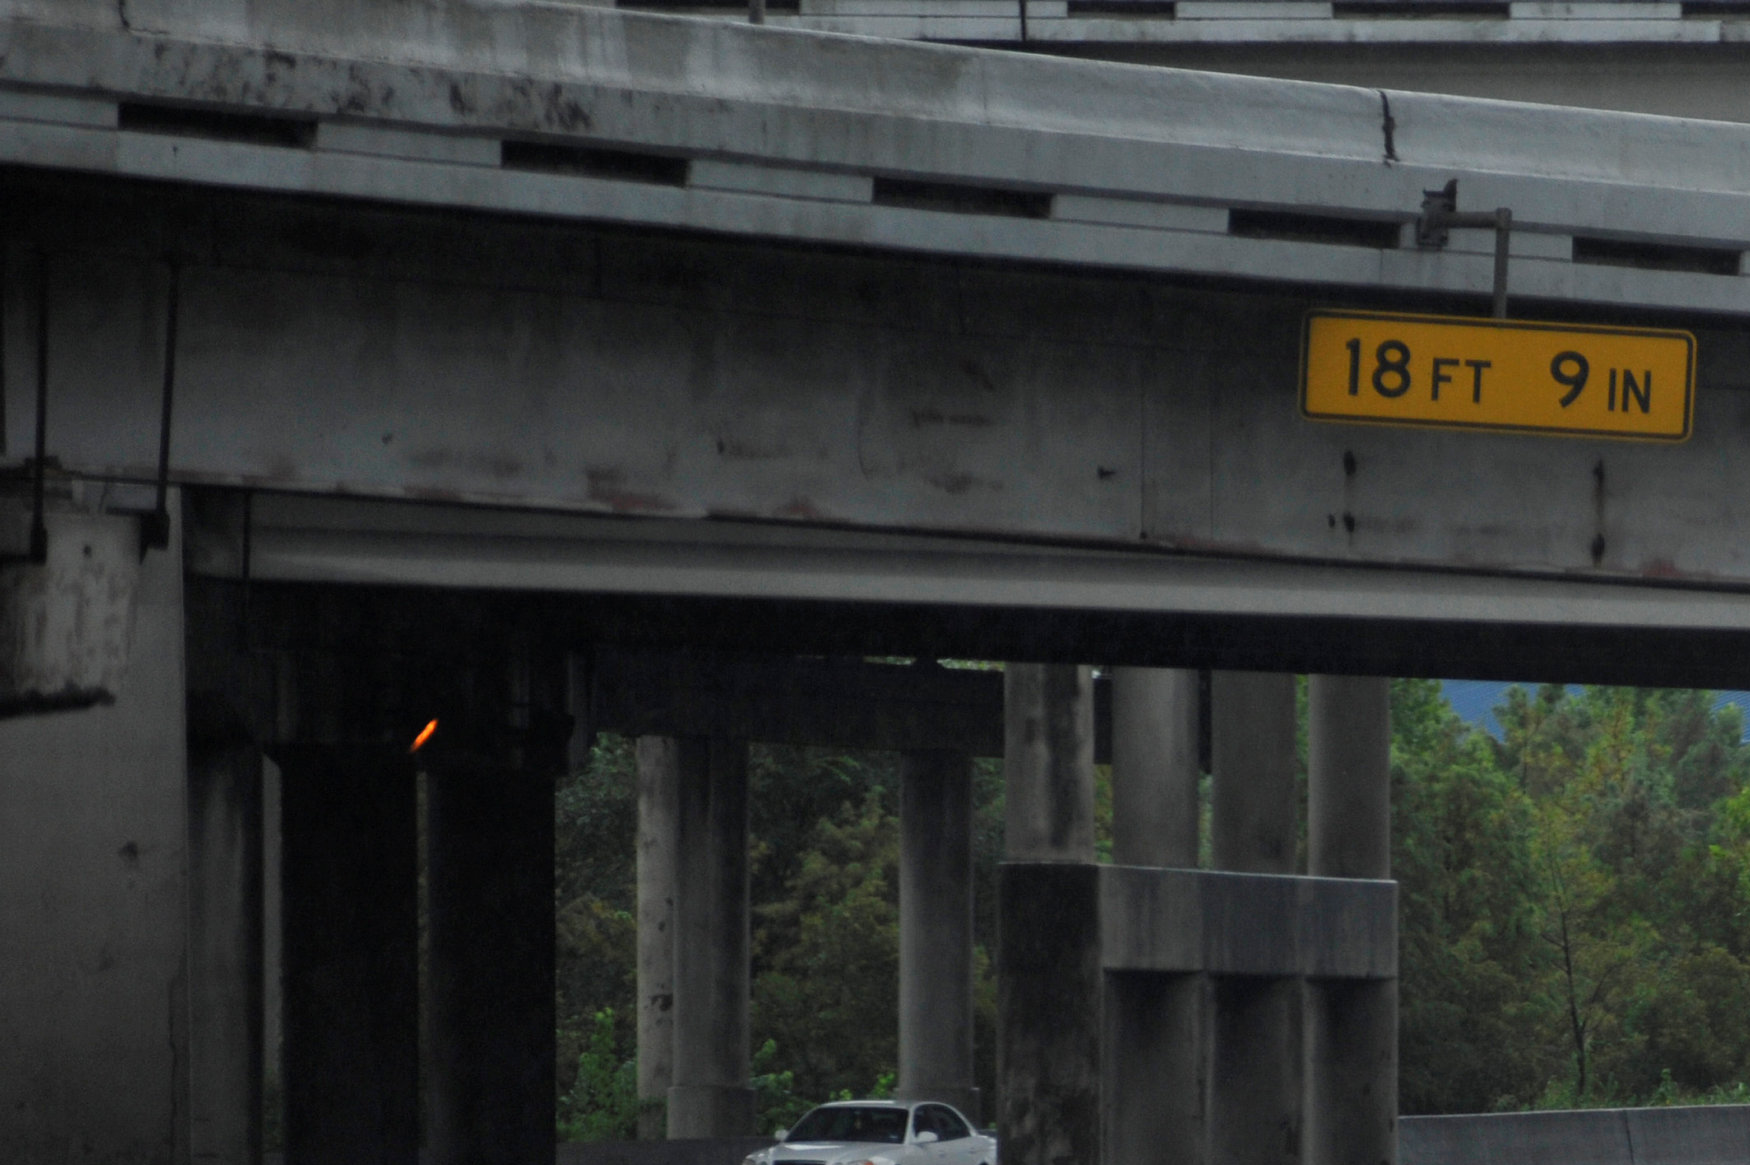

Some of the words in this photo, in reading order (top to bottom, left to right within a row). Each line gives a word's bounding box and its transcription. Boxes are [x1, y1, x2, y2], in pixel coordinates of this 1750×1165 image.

[1345, 338, 1412, 399] 18
[1431, 357, 1492, 404] FT
[1550, 350, 1590, 409] 9
[1608, 368, 1652, 414] IN
